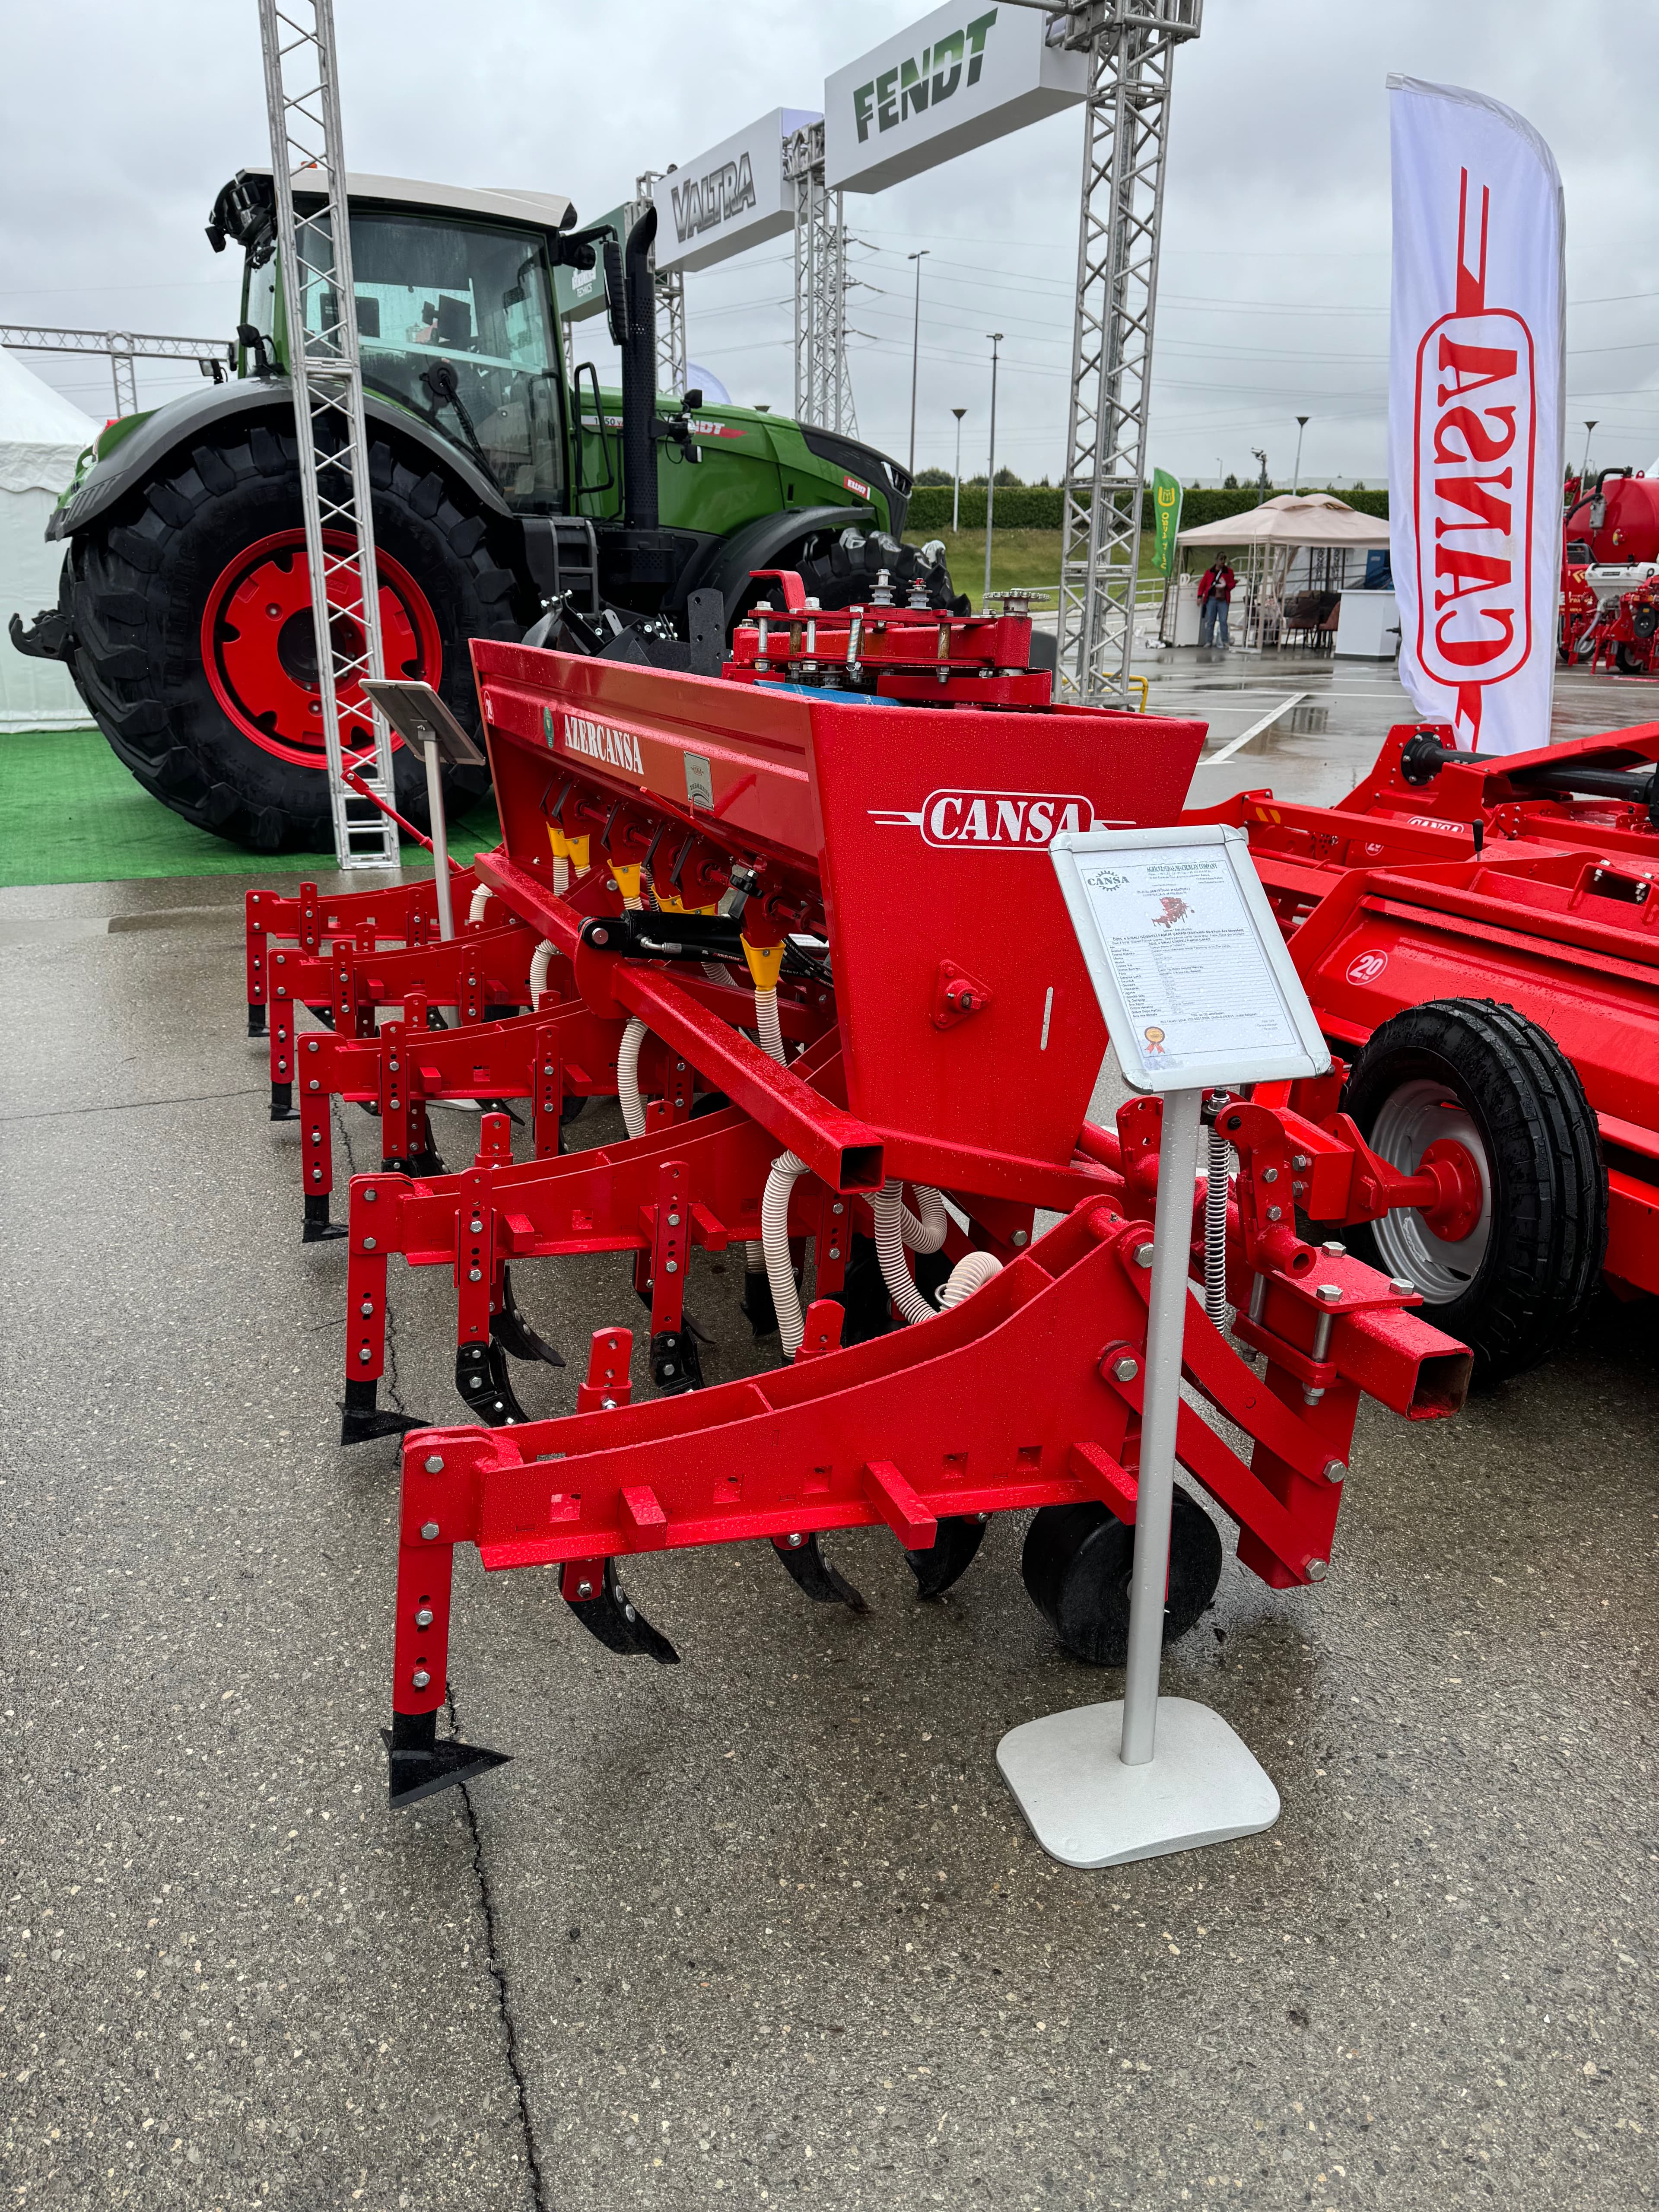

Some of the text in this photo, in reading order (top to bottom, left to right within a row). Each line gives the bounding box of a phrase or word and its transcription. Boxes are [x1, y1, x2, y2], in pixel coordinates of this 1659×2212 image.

[854, 7, 998, 143] FENDT
[671, 151, 756, 243] VALTRA
[594, 417, 615, 426] 150
[564, 714, 644, 775] AZERCANSA
[931, 798, 1079, 842] CANSA
[1087, 876, 1130, 886] CANSA
[1349, 955, 1383, 979] 20
